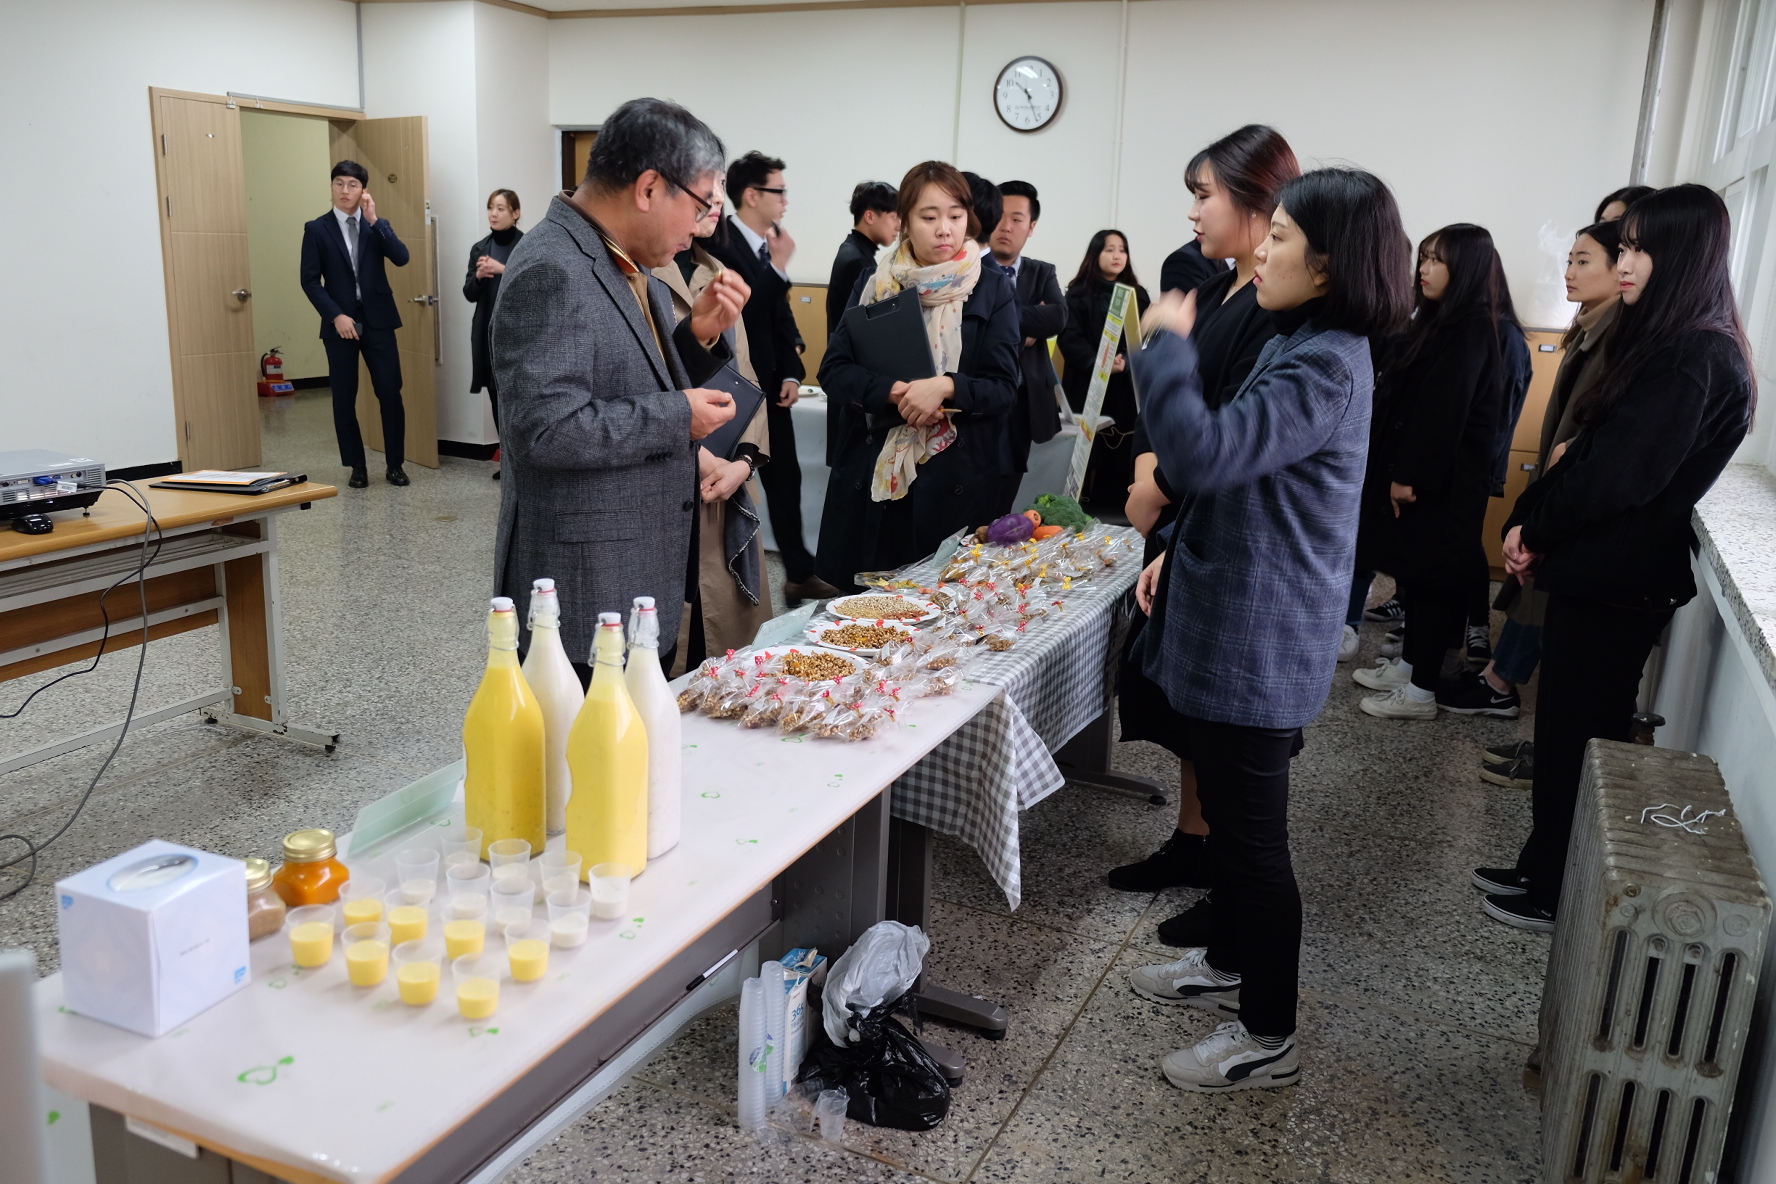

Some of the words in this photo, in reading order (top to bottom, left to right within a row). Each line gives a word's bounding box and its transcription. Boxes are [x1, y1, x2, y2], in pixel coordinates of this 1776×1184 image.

[1047, 78, 1051, 87] 2
[1003, 92, 1008, 100] 9
[1006, 105, 1011, 113] 8
[1015, 113, 1020, 121] 7
[1025, 116, 1030, 125] 6
